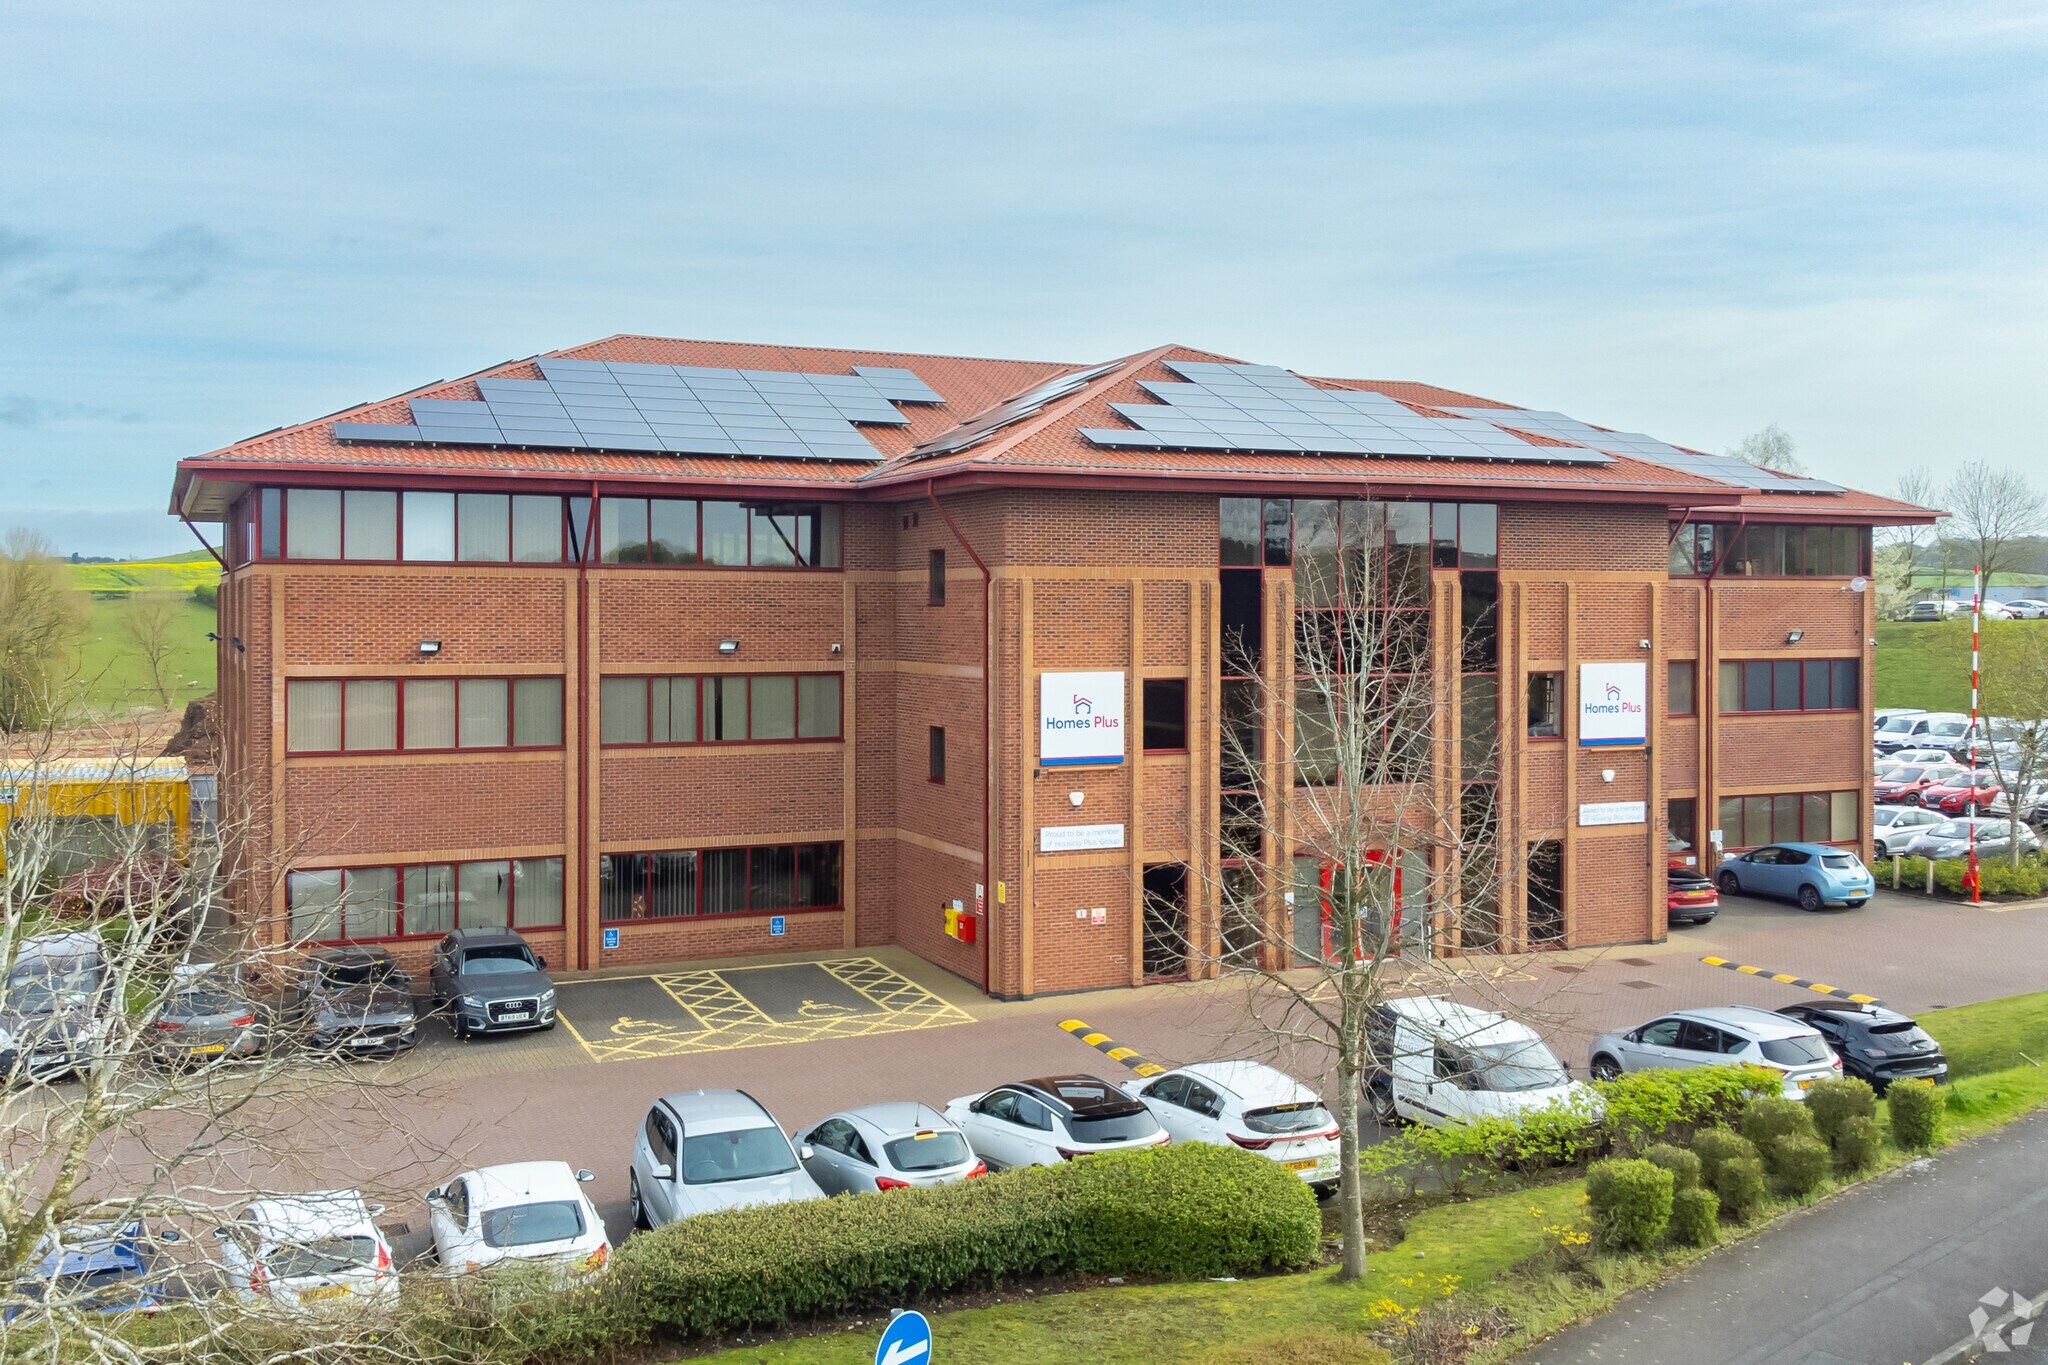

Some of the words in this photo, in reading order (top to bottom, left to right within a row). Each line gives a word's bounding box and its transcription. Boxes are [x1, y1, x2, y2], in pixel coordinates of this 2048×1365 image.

[1585, 703, 1619, 714] Homes
[1622, 702, 1641, 713] Plus
[1046, 717, 1091, 729] Homes
[1094, 715, 1119, 728] Plus
[1045, 830, 1065, 838] Proud
[1091, 828, 1120, 836] member
[1045, 840, 1053, 848] of
[1054, 840, 1082, 849] Housing
[1083, 838, 1097, 846] Plus
